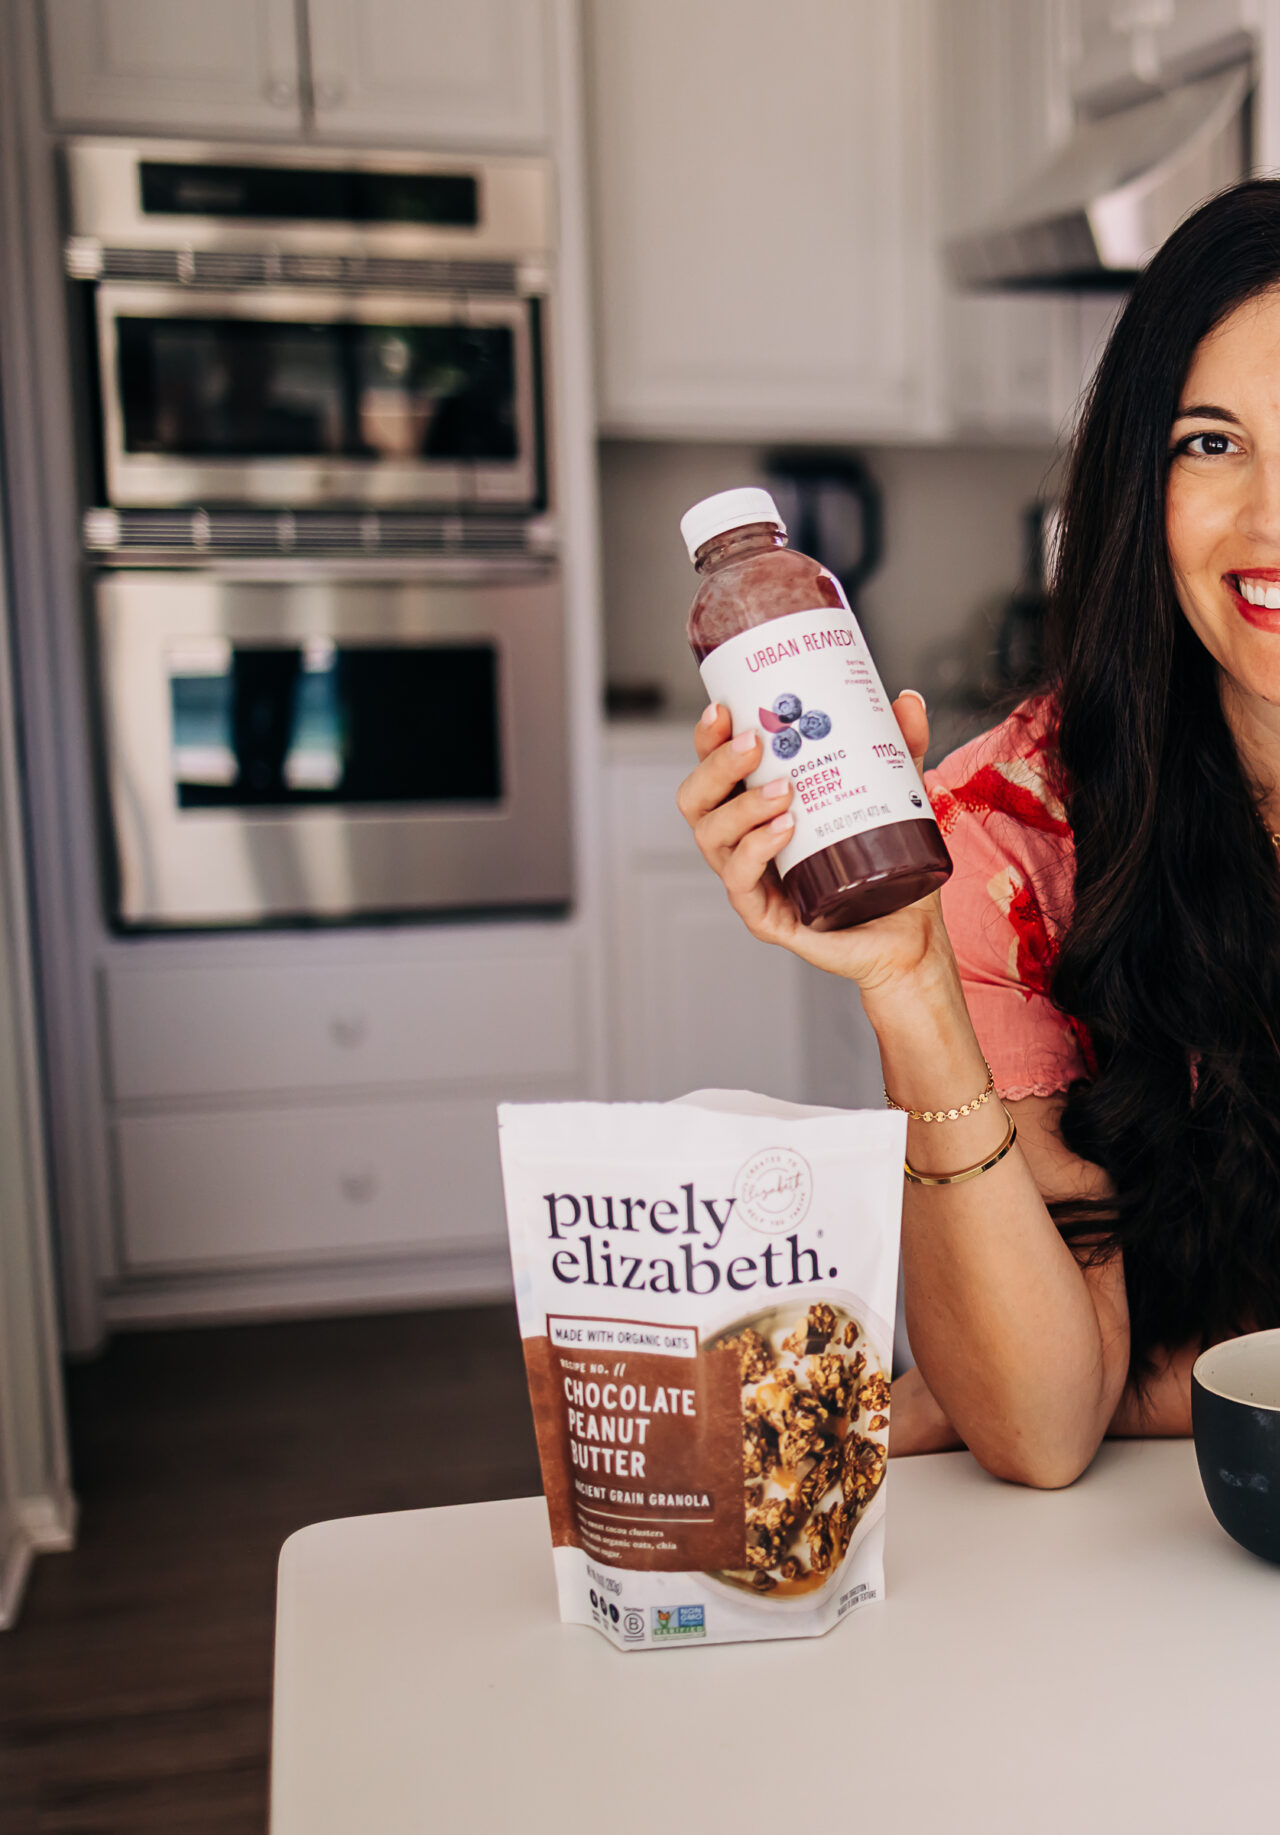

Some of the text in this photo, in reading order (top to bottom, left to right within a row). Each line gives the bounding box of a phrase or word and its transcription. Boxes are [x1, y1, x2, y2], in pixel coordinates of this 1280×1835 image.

[745, 629, 857, 672] URBAN REMEDY
[791, 750, 846, 777] ORGANIC
[796, 766, 840, 792] GREEN
[801, 778, 842, 804] BERRY
[806, 785, 868, 813] MEAL SHAKE
[543, 1182, 738, 1250] purely
[552, 1234, 838, 1295] elizabeth.
[555, 1328, 689, 1349] MADE WITH ORGANIC OATS
[560, 1358, 586, 1374] RECIPE
[590, 1363, 609, 1375] NO.
[564, 1376, 697, 1417] CHOCOLATE
[568, 1407, 651, 1445] PEANUT
[570, 1439, 646, 1478] BUTTER
[609, 1489, 644, 1505] GRAIN
[648, 1493, 710, 1507] GRANOLA
[602, 1536, 631, 1547] organic
[632, 1541, 655, 1551] oats,
[656, 1541, 677, 1550] chia
[628, 1528, 665, 1538] clusters
[629, 1617, 639, 1631] B
